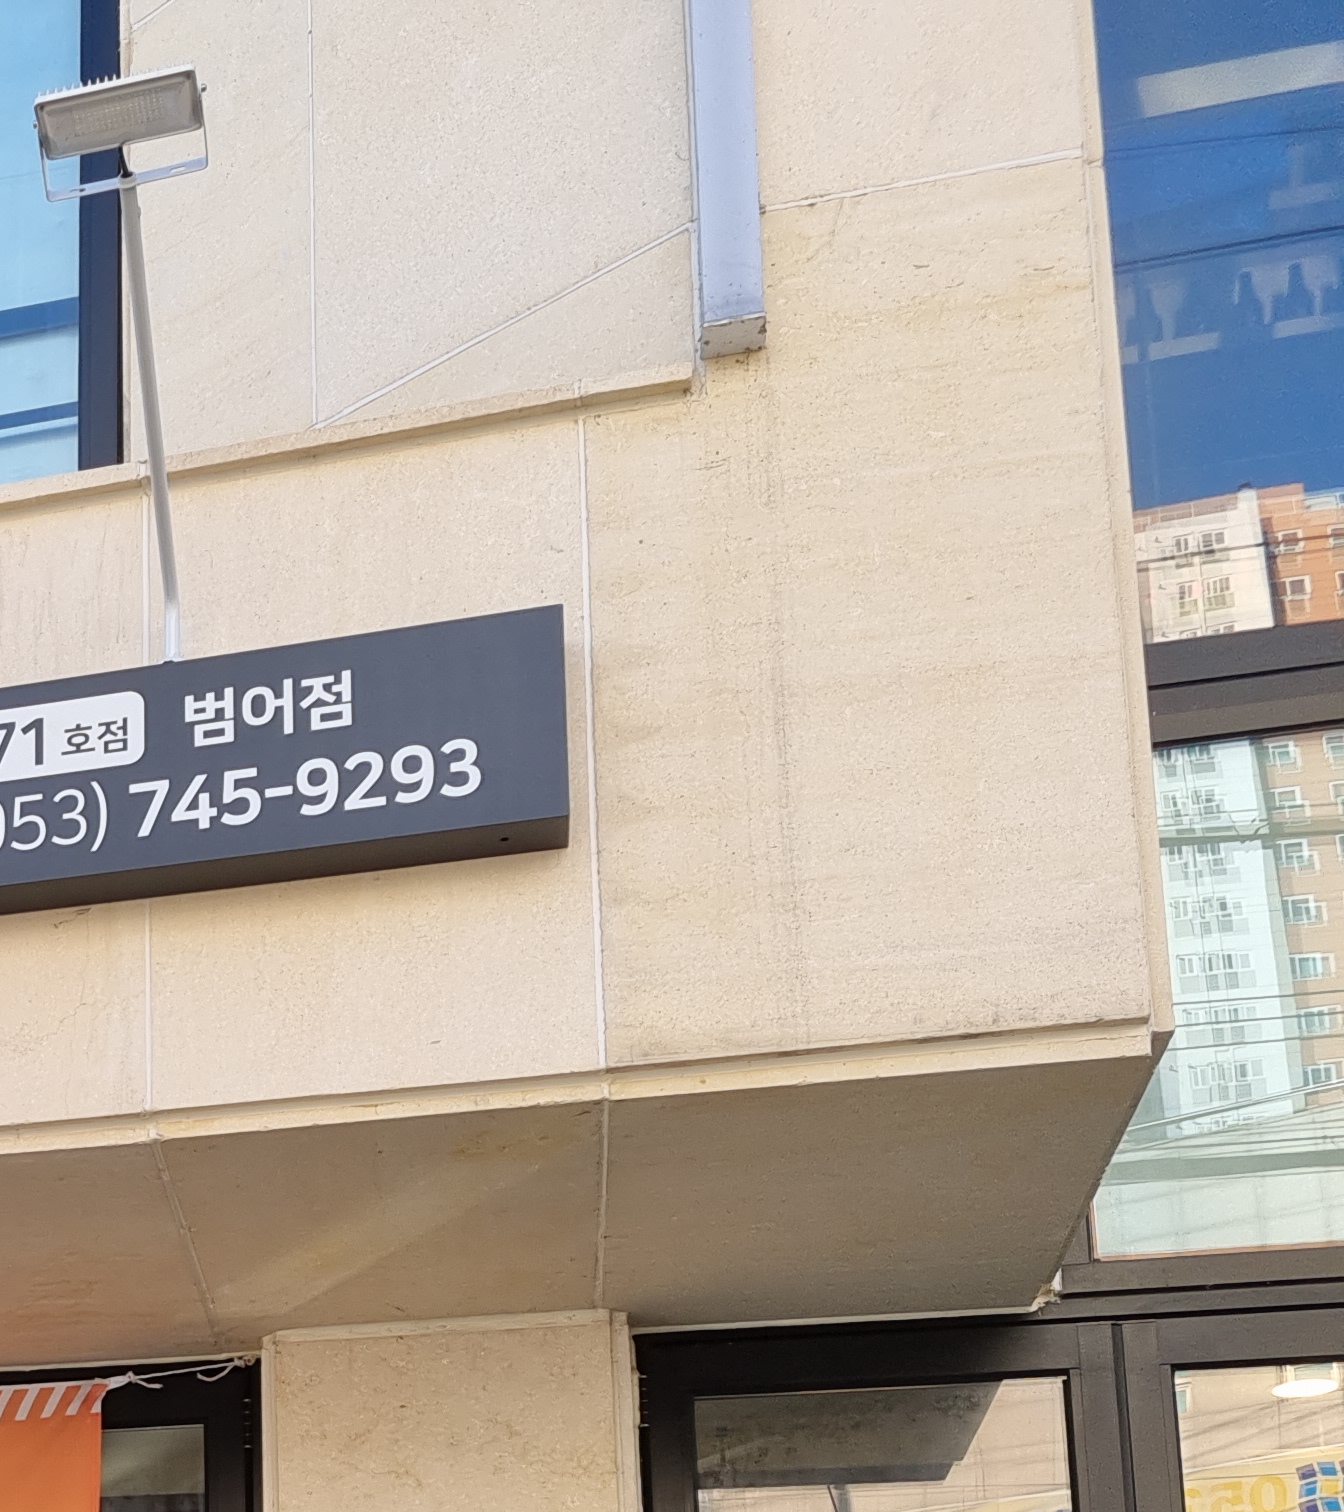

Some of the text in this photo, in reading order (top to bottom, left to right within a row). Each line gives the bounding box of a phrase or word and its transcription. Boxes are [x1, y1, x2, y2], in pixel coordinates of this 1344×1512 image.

[60, 716, 132, 757] 호점
[182, 670, 356, 748] 범어점
[126, 738, 484, 840] 745-9293
